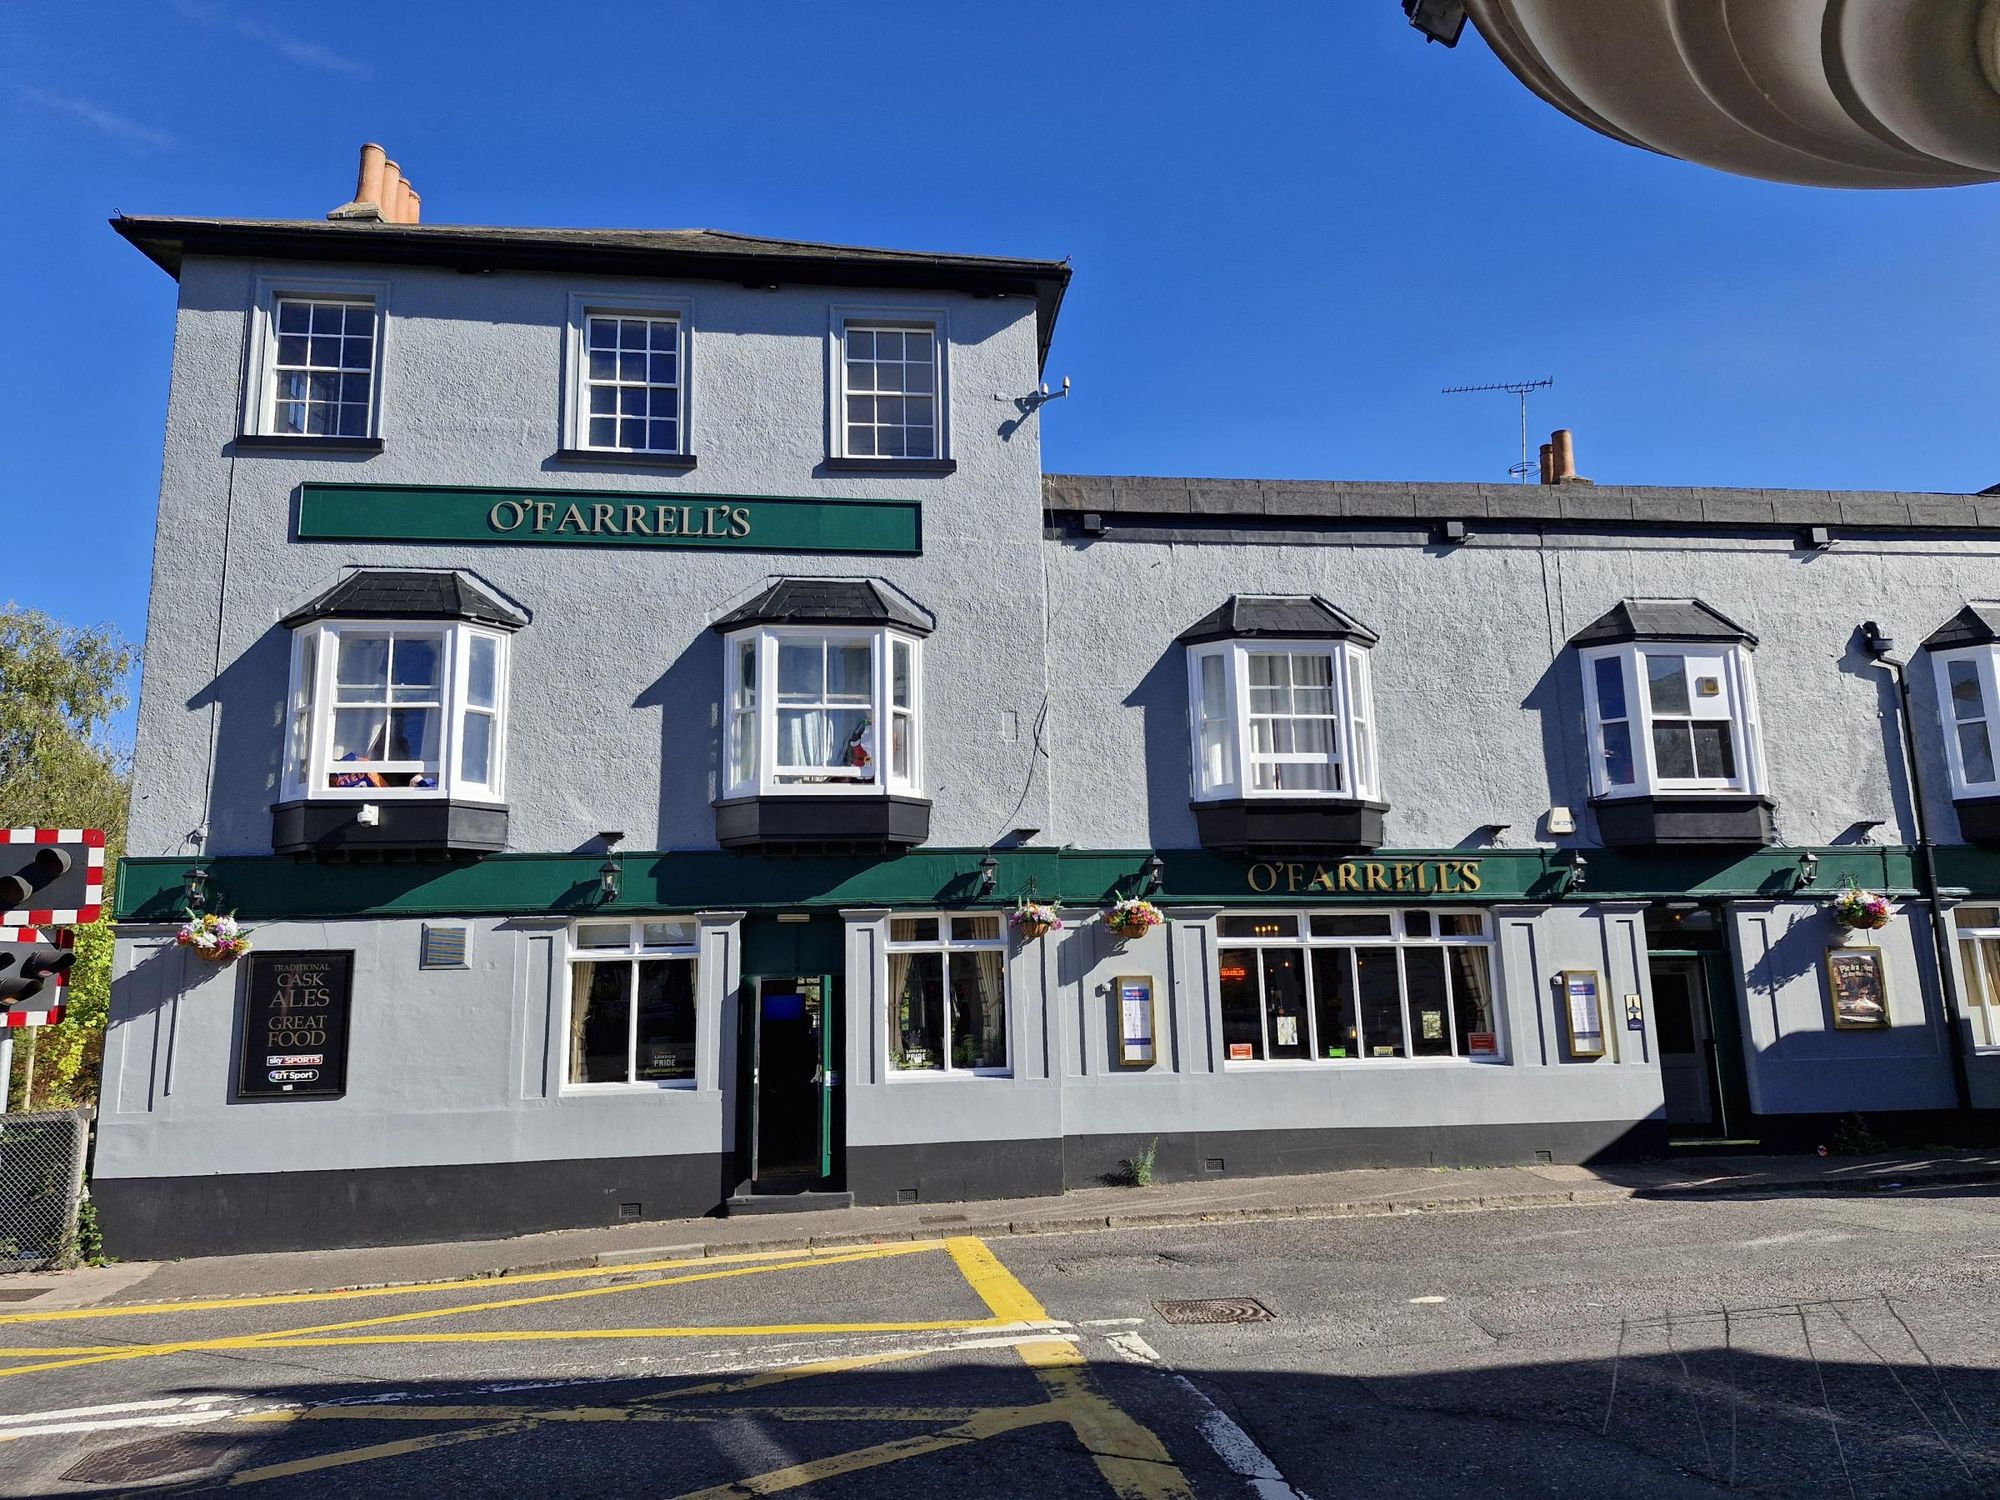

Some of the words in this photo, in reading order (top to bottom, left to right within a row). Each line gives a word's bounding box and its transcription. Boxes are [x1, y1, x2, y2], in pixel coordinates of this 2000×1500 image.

[490, 499, 751, 537] O'FARRELL'S
[1247, 861, 1482, 892] O'FARRELL'S
[273, 963, 330, 972] TRADITIONAL
[277, 972, 325, 987] CASK
[269, 988, 330, 1008] ALES
[268, 1015, 328, 1031] GREAT
[267, 1030, 326, 1047] FOOD
[269, 1056, 283, 1065] sky
[654, 1059, 676, 1067] PRIDE
[906, 1053, 927, 1061] PRIDE
[289, 1071, 313, 1080] Sport
